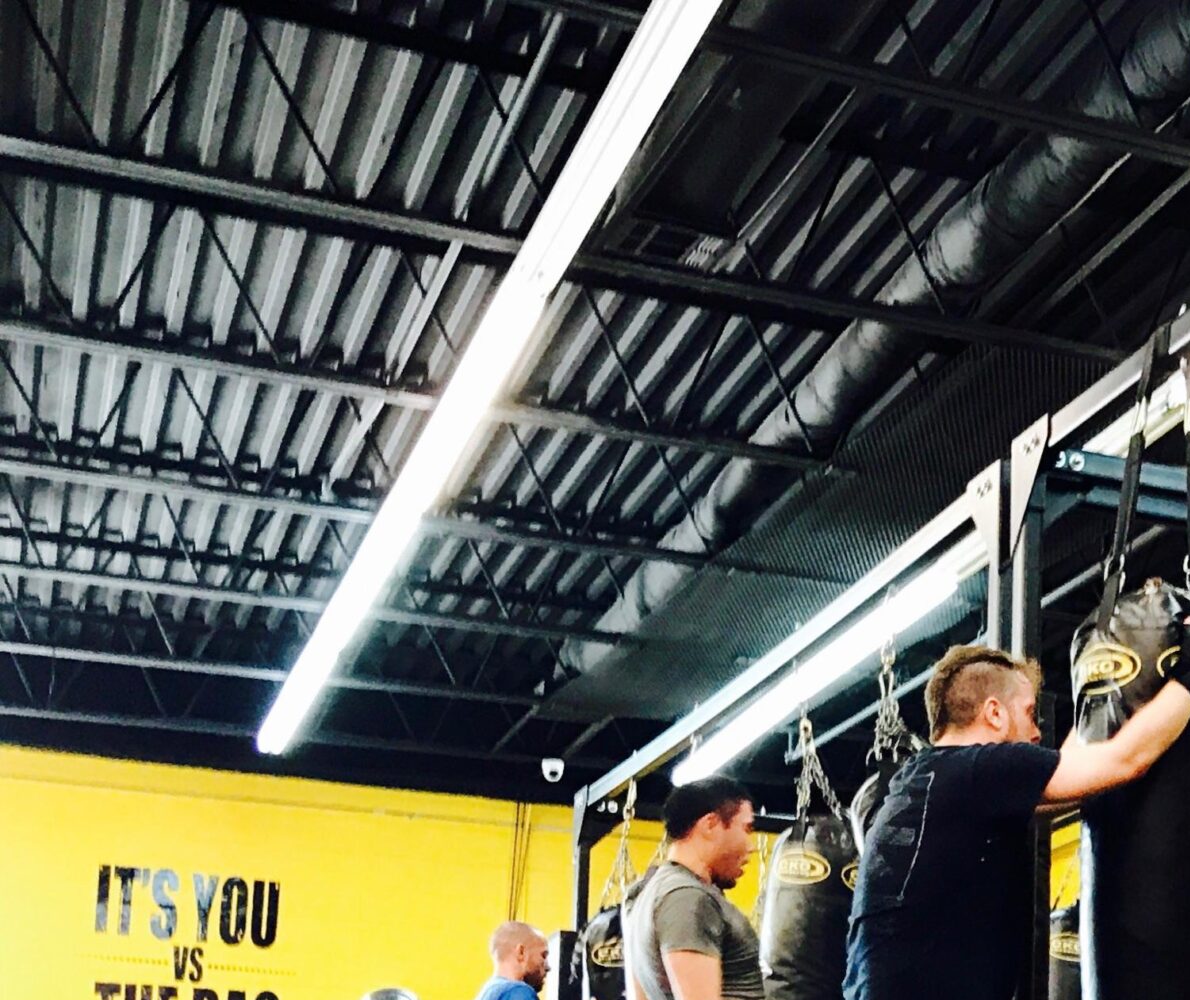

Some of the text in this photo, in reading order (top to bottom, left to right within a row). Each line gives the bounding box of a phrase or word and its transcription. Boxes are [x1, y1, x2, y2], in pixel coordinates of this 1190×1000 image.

[94, 864, 281, 949] IT'S YOU
[173, 945, 204, 983] VS
